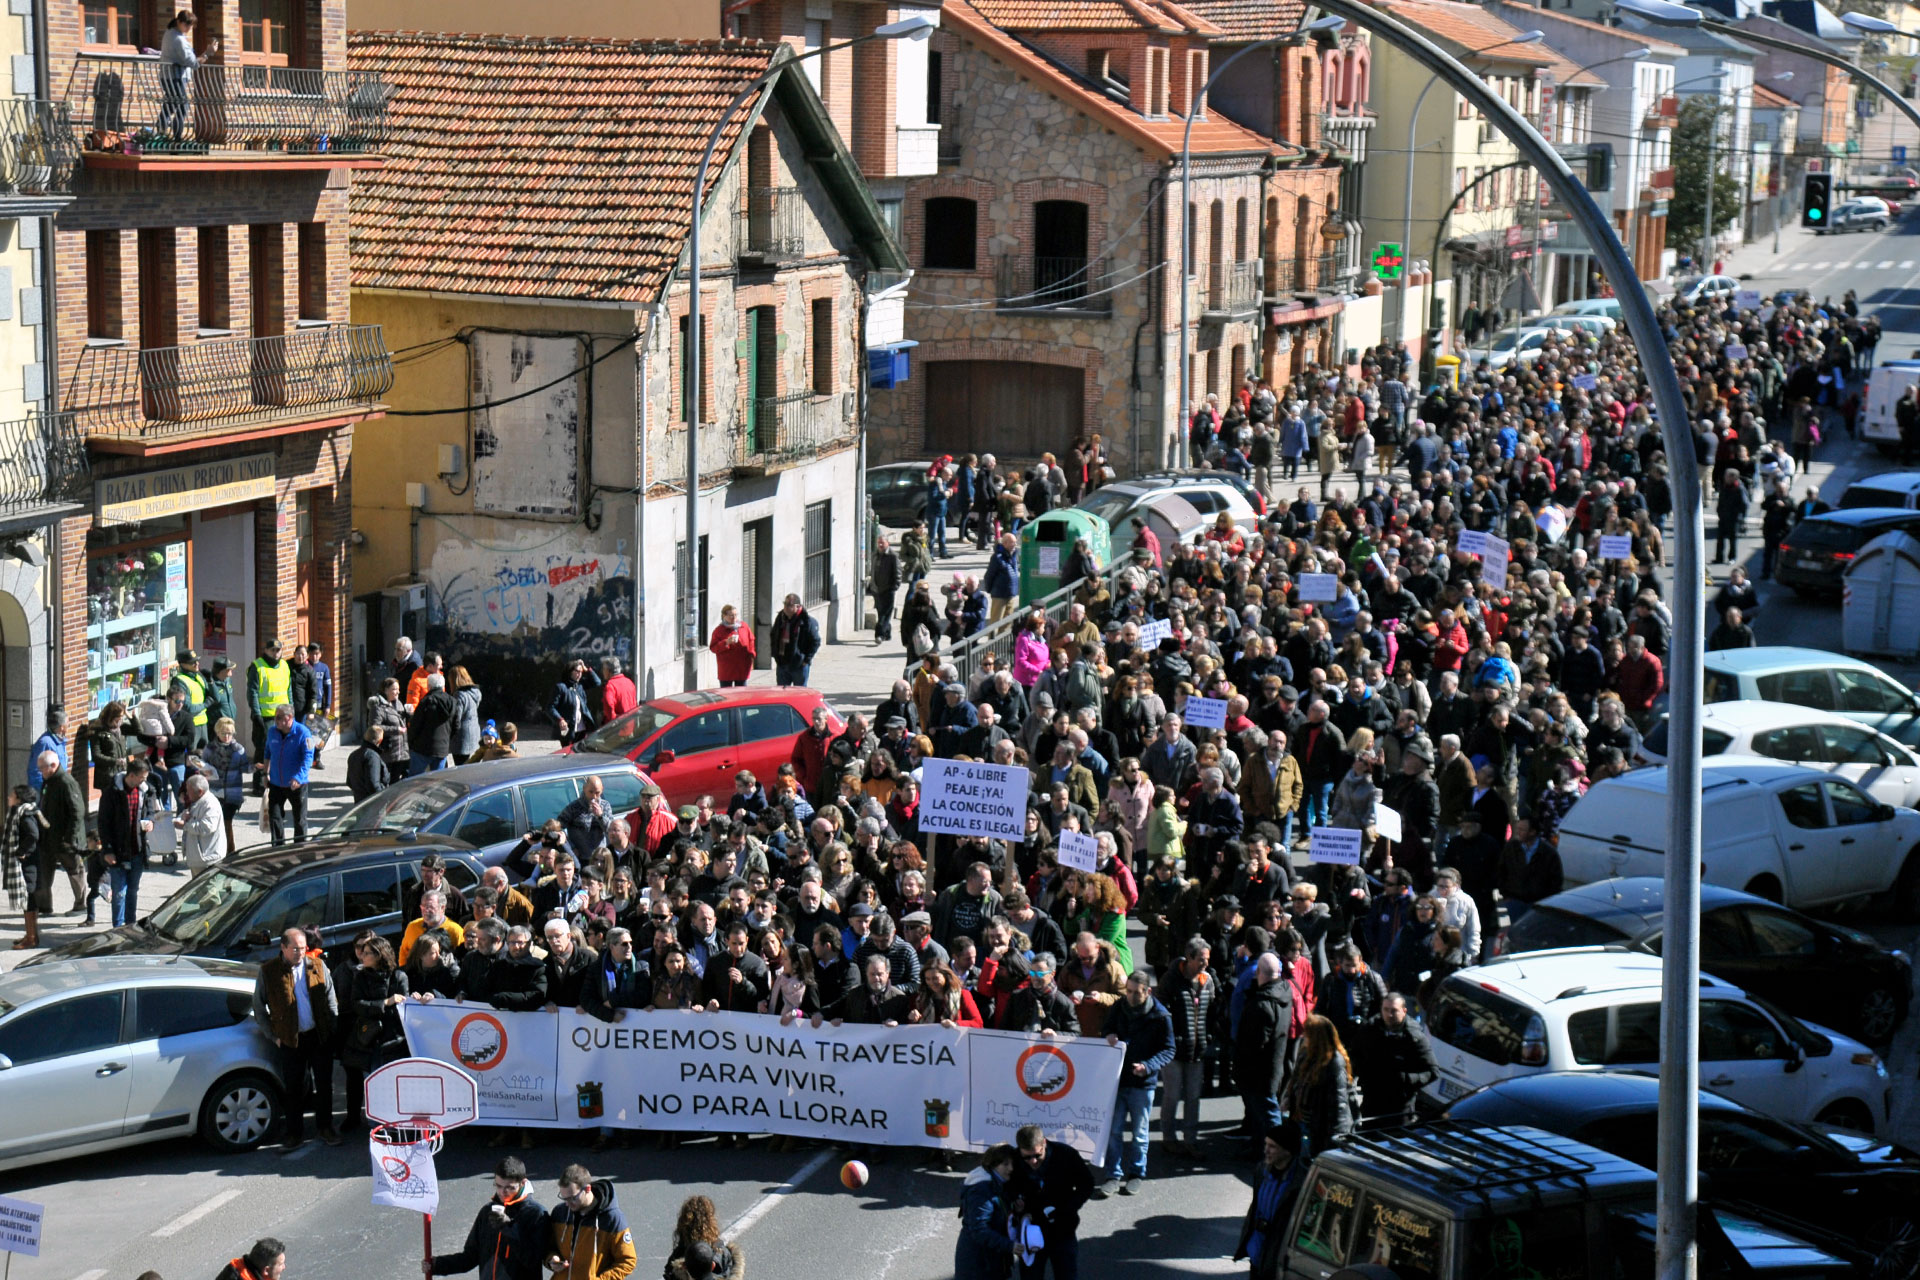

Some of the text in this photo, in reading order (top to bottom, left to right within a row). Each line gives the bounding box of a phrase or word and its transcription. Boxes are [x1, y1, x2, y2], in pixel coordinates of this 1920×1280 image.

[106, 479, 146, 505] BAZAR
[153, 472, 187, 497] CHINA
[194, 463, 234, 489] PRECIO
[976, 768, 1007, 783] LIBRE
[945, 783, 1004, 799] PEAJE ¡YA!
[932, 799, 1015, 818] LA CONCESIÓN
[921, 815, 1023, 836] ACTUAL ES ILEGAL
[571, 1026, 956, 1066] QUEREMOS UNA TRAVESÍA
[680, 1062, 845, 1098] PARA VIVIR,
[638, 1094, 889, 1130] NO PARA LLORAR
